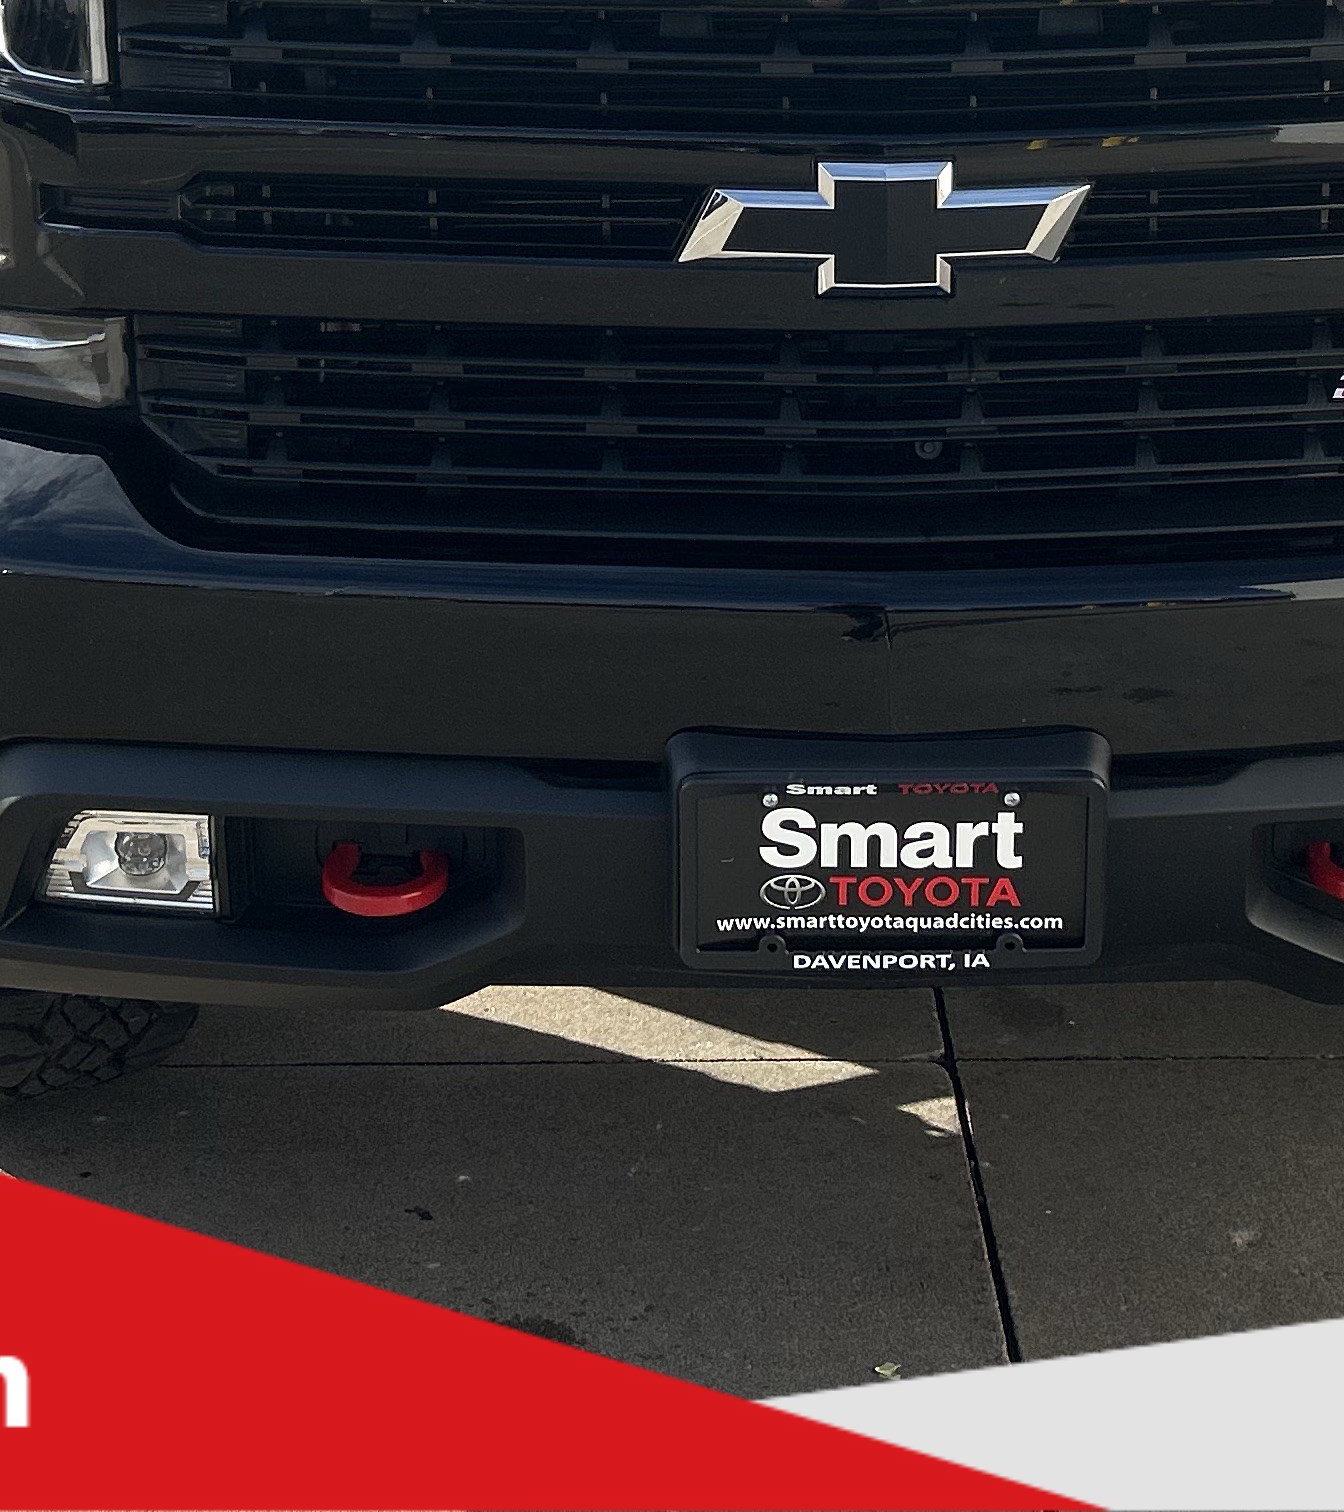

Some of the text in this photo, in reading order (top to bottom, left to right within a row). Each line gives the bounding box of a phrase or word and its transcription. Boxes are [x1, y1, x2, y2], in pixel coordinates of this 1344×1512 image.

[785, 783, 999, 796] Smart TOYOTA
[759, 807, 1023, 869] Smart
[829, 875, 1022, 907] TOYOTA
[716, 912, 1063, 933] www.smarttoyotaquadcities.com
[793, 952, 991, 971] DAVENPORT, IA
